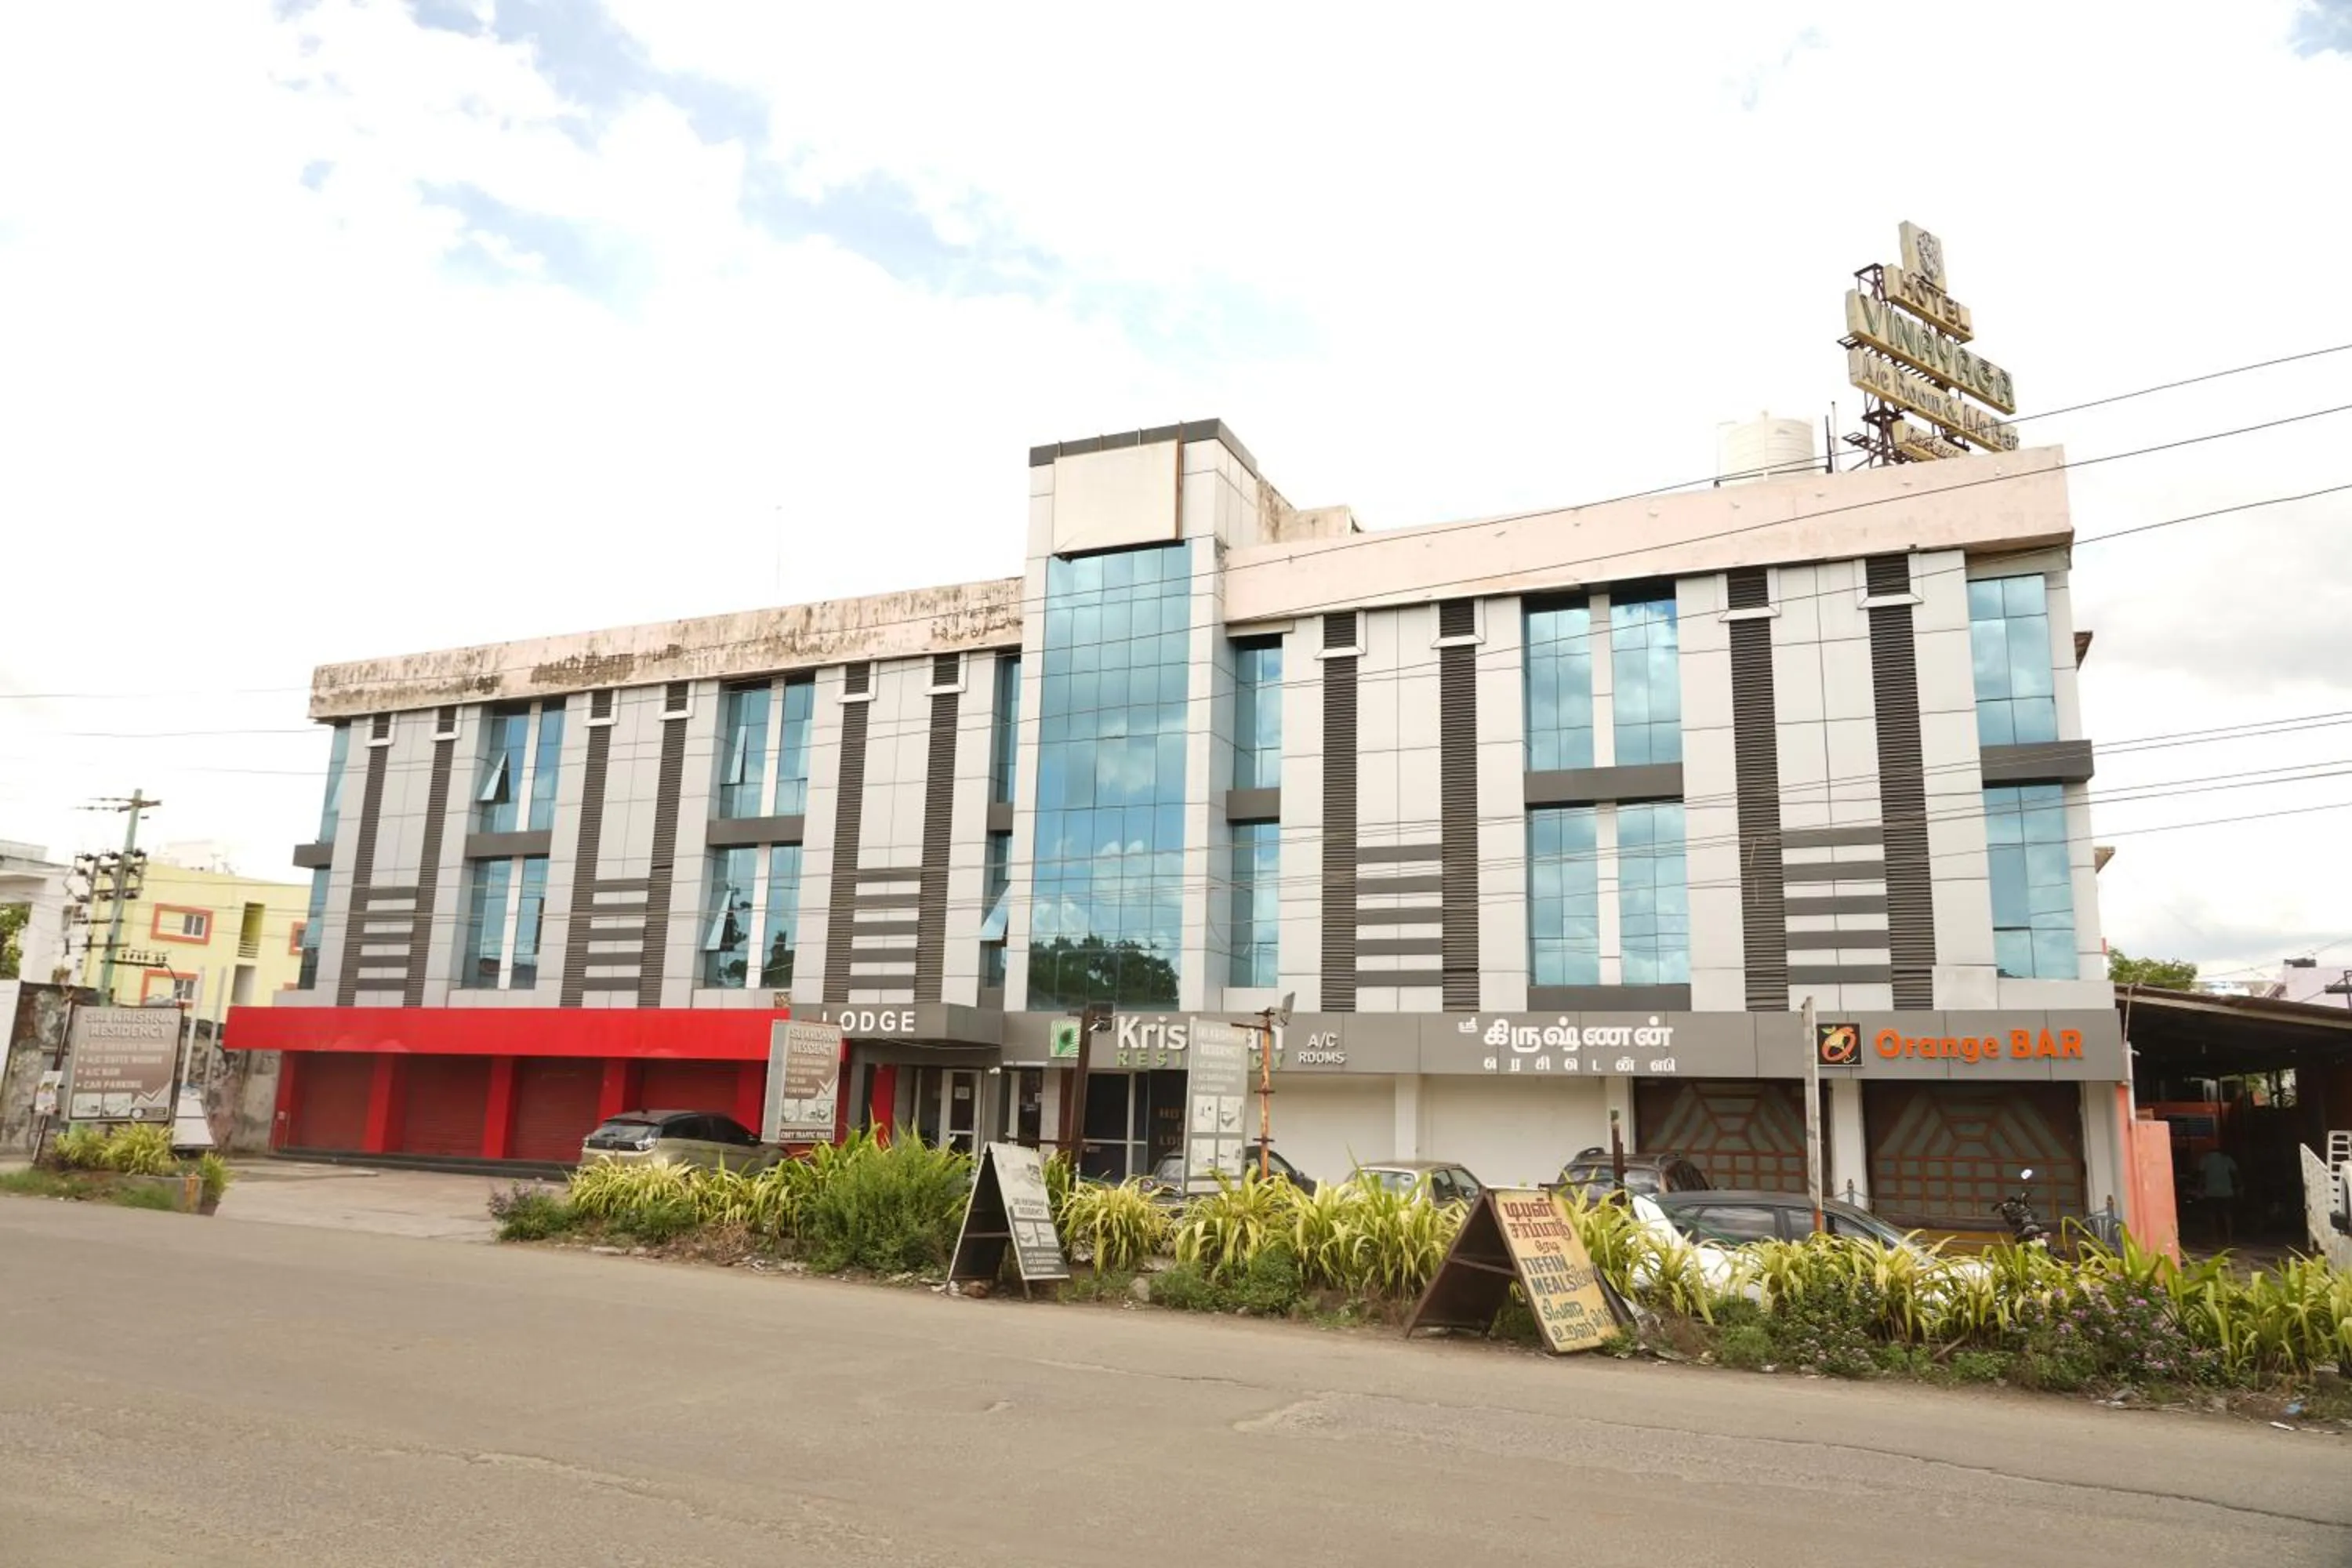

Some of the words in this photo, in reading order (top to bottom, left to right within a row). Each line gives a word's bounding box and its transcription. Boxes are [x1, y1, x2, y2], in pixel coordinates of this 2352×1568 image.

[1901, 269, 1970, 332] HOTEL
[1860, 293, 2015, 408] VINAYAGA
[1307, 1031, 1338, 1048] A/C
[1483, 1015, 1674, 1053] கிருஷ்ணன்
[1875, 1027, 1999, 1064] Orange
[2009, 1027, 2084, 1060] BAR
[1298, 1051, 1346, 1065] ROOMS
[1520, 1254, 1569, 1276] TIFFIN
[1530, 1274, 1577, 1296] MEALS
